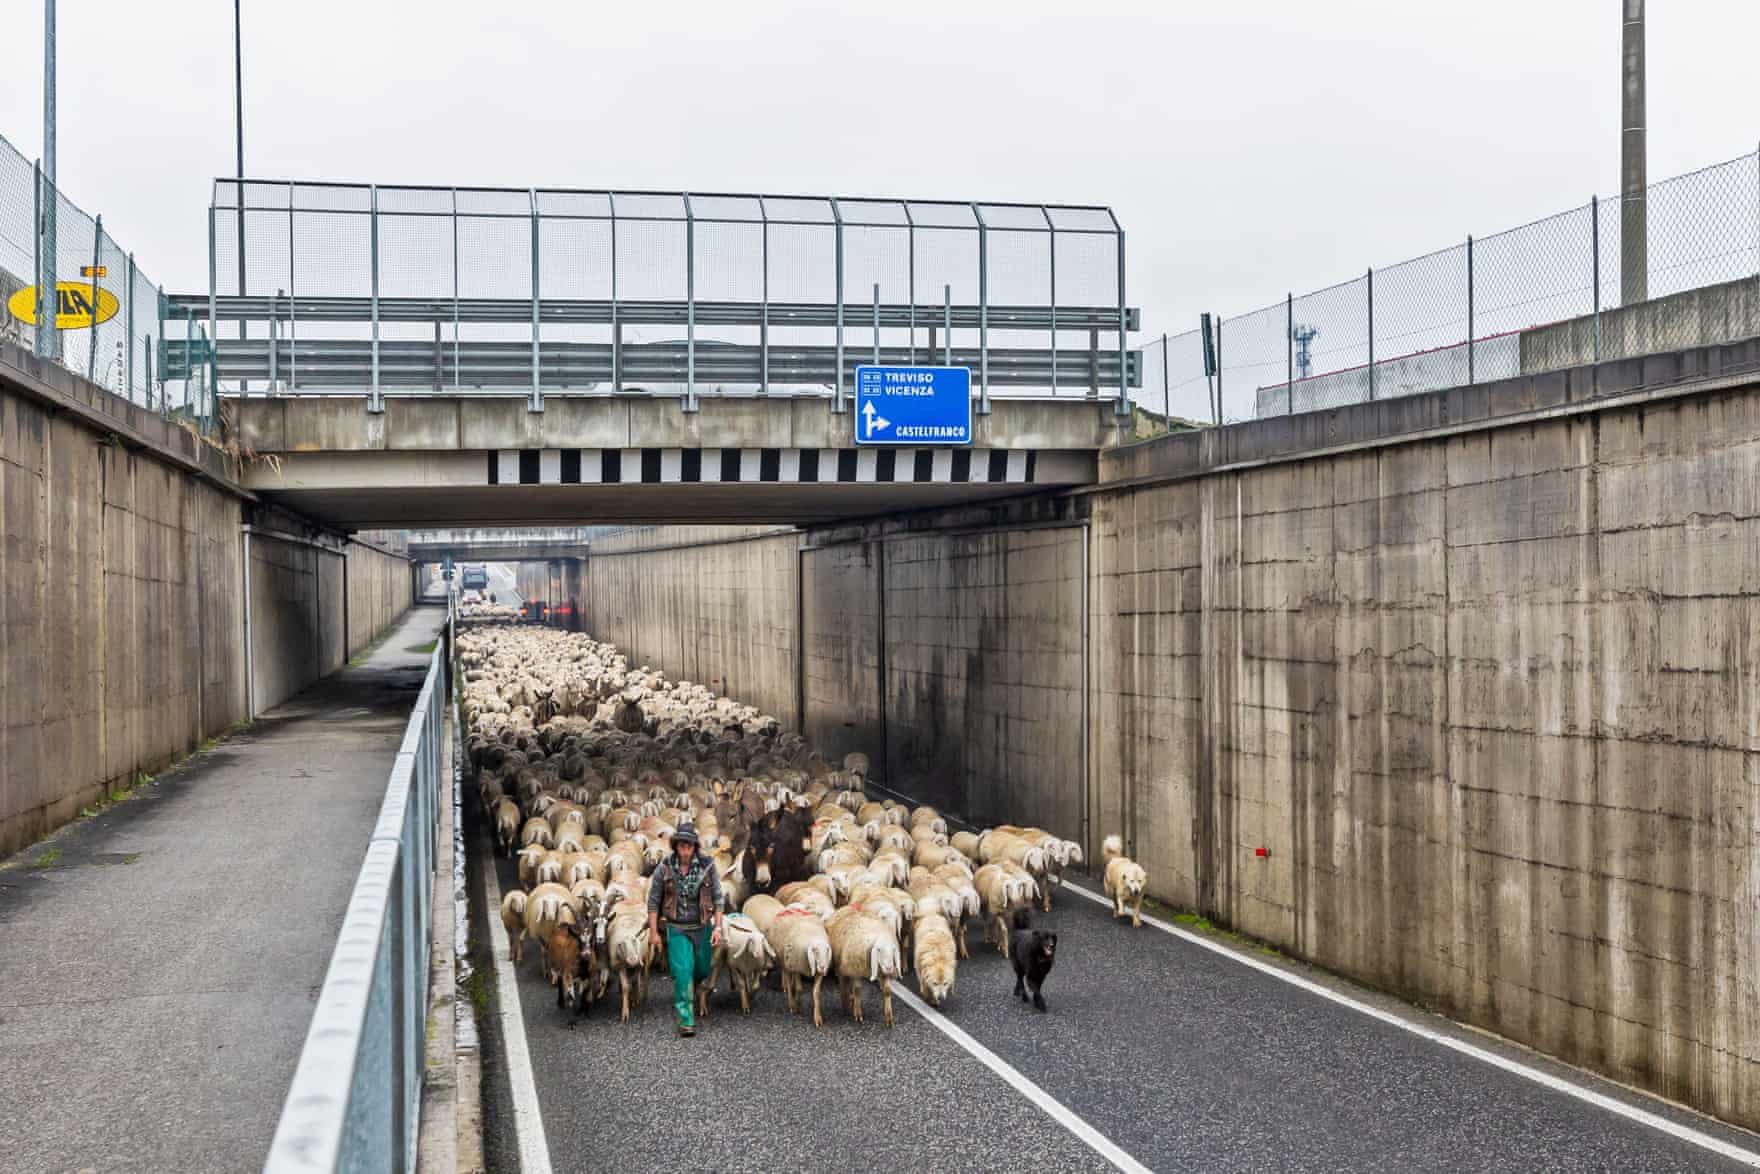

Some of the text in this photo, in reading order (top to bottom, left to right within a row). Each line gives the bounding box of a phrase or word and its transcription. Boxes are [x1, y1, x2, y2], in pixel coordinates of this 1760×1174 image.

[885, 373, 934, 383] TREVISO
[885, 386, 935, 396] VICENZA
[896, 426, 966, 437] CASTELFRANCO
